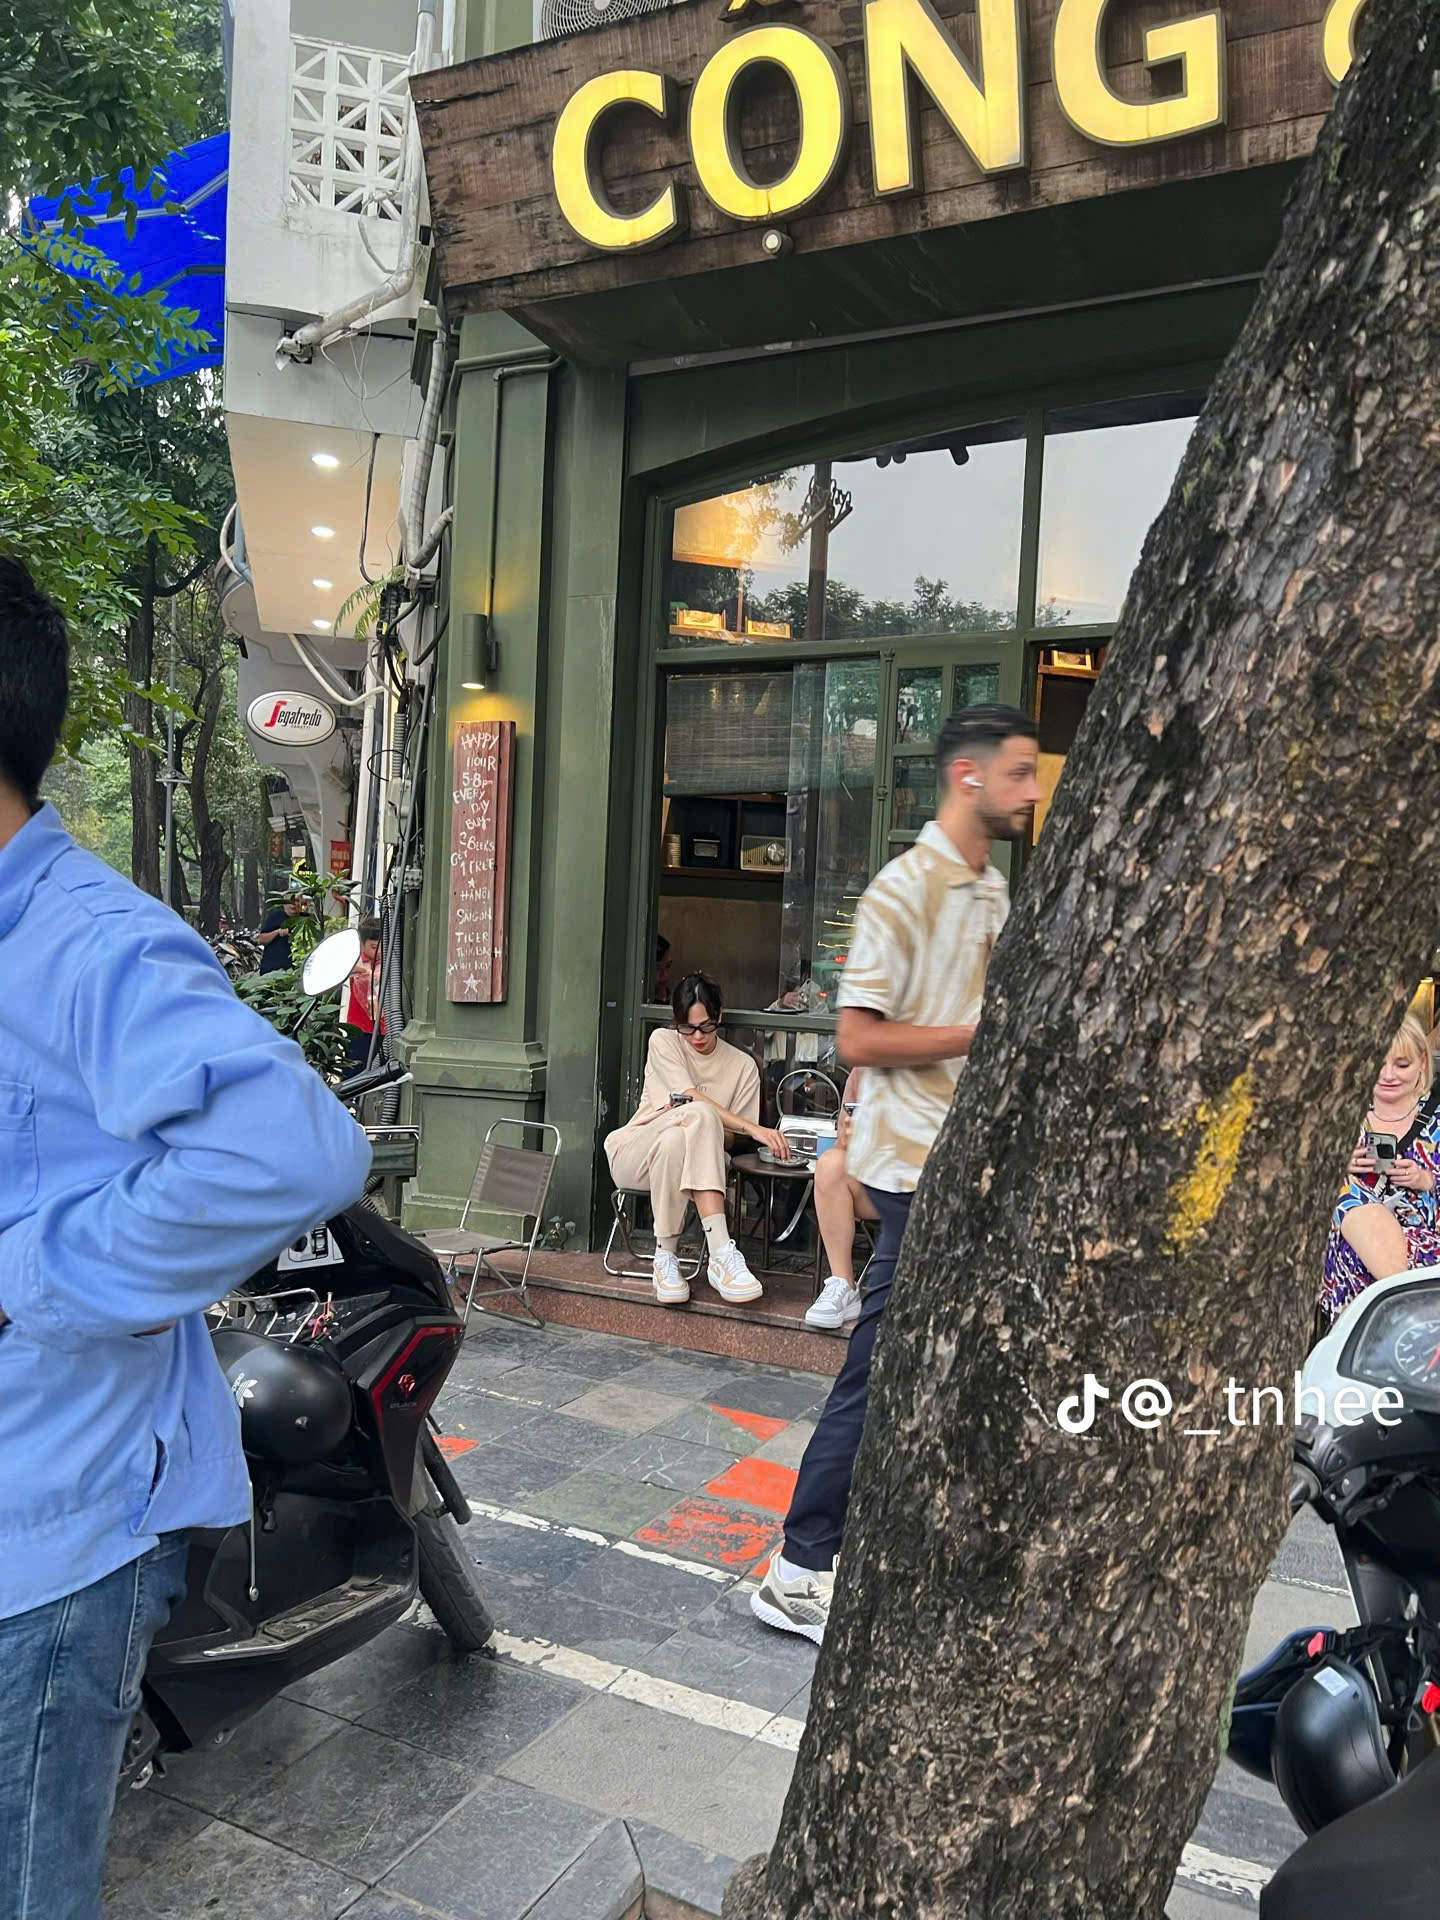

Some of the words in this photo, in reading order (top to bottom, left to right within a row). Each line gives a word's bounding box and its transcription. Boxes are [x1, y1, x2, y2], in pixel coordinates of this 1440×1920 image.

[264, 700, 322, 727] Segafredo
[461, 731, 499, 750] HAPPY
[467, 755, 497, 771] HOUR
[453, 787, 485, 804] EVERY
[471, 799, 490, 815] DAY
[465, 815, 491, 831] BUY
[459, 831, 467, 846] 2
[450, 850, 468, 866] GET
[460, 861, 466, 877] 1
[469, 858, 494, 874] FREE
[455, 931, 489, 943] TIGER
